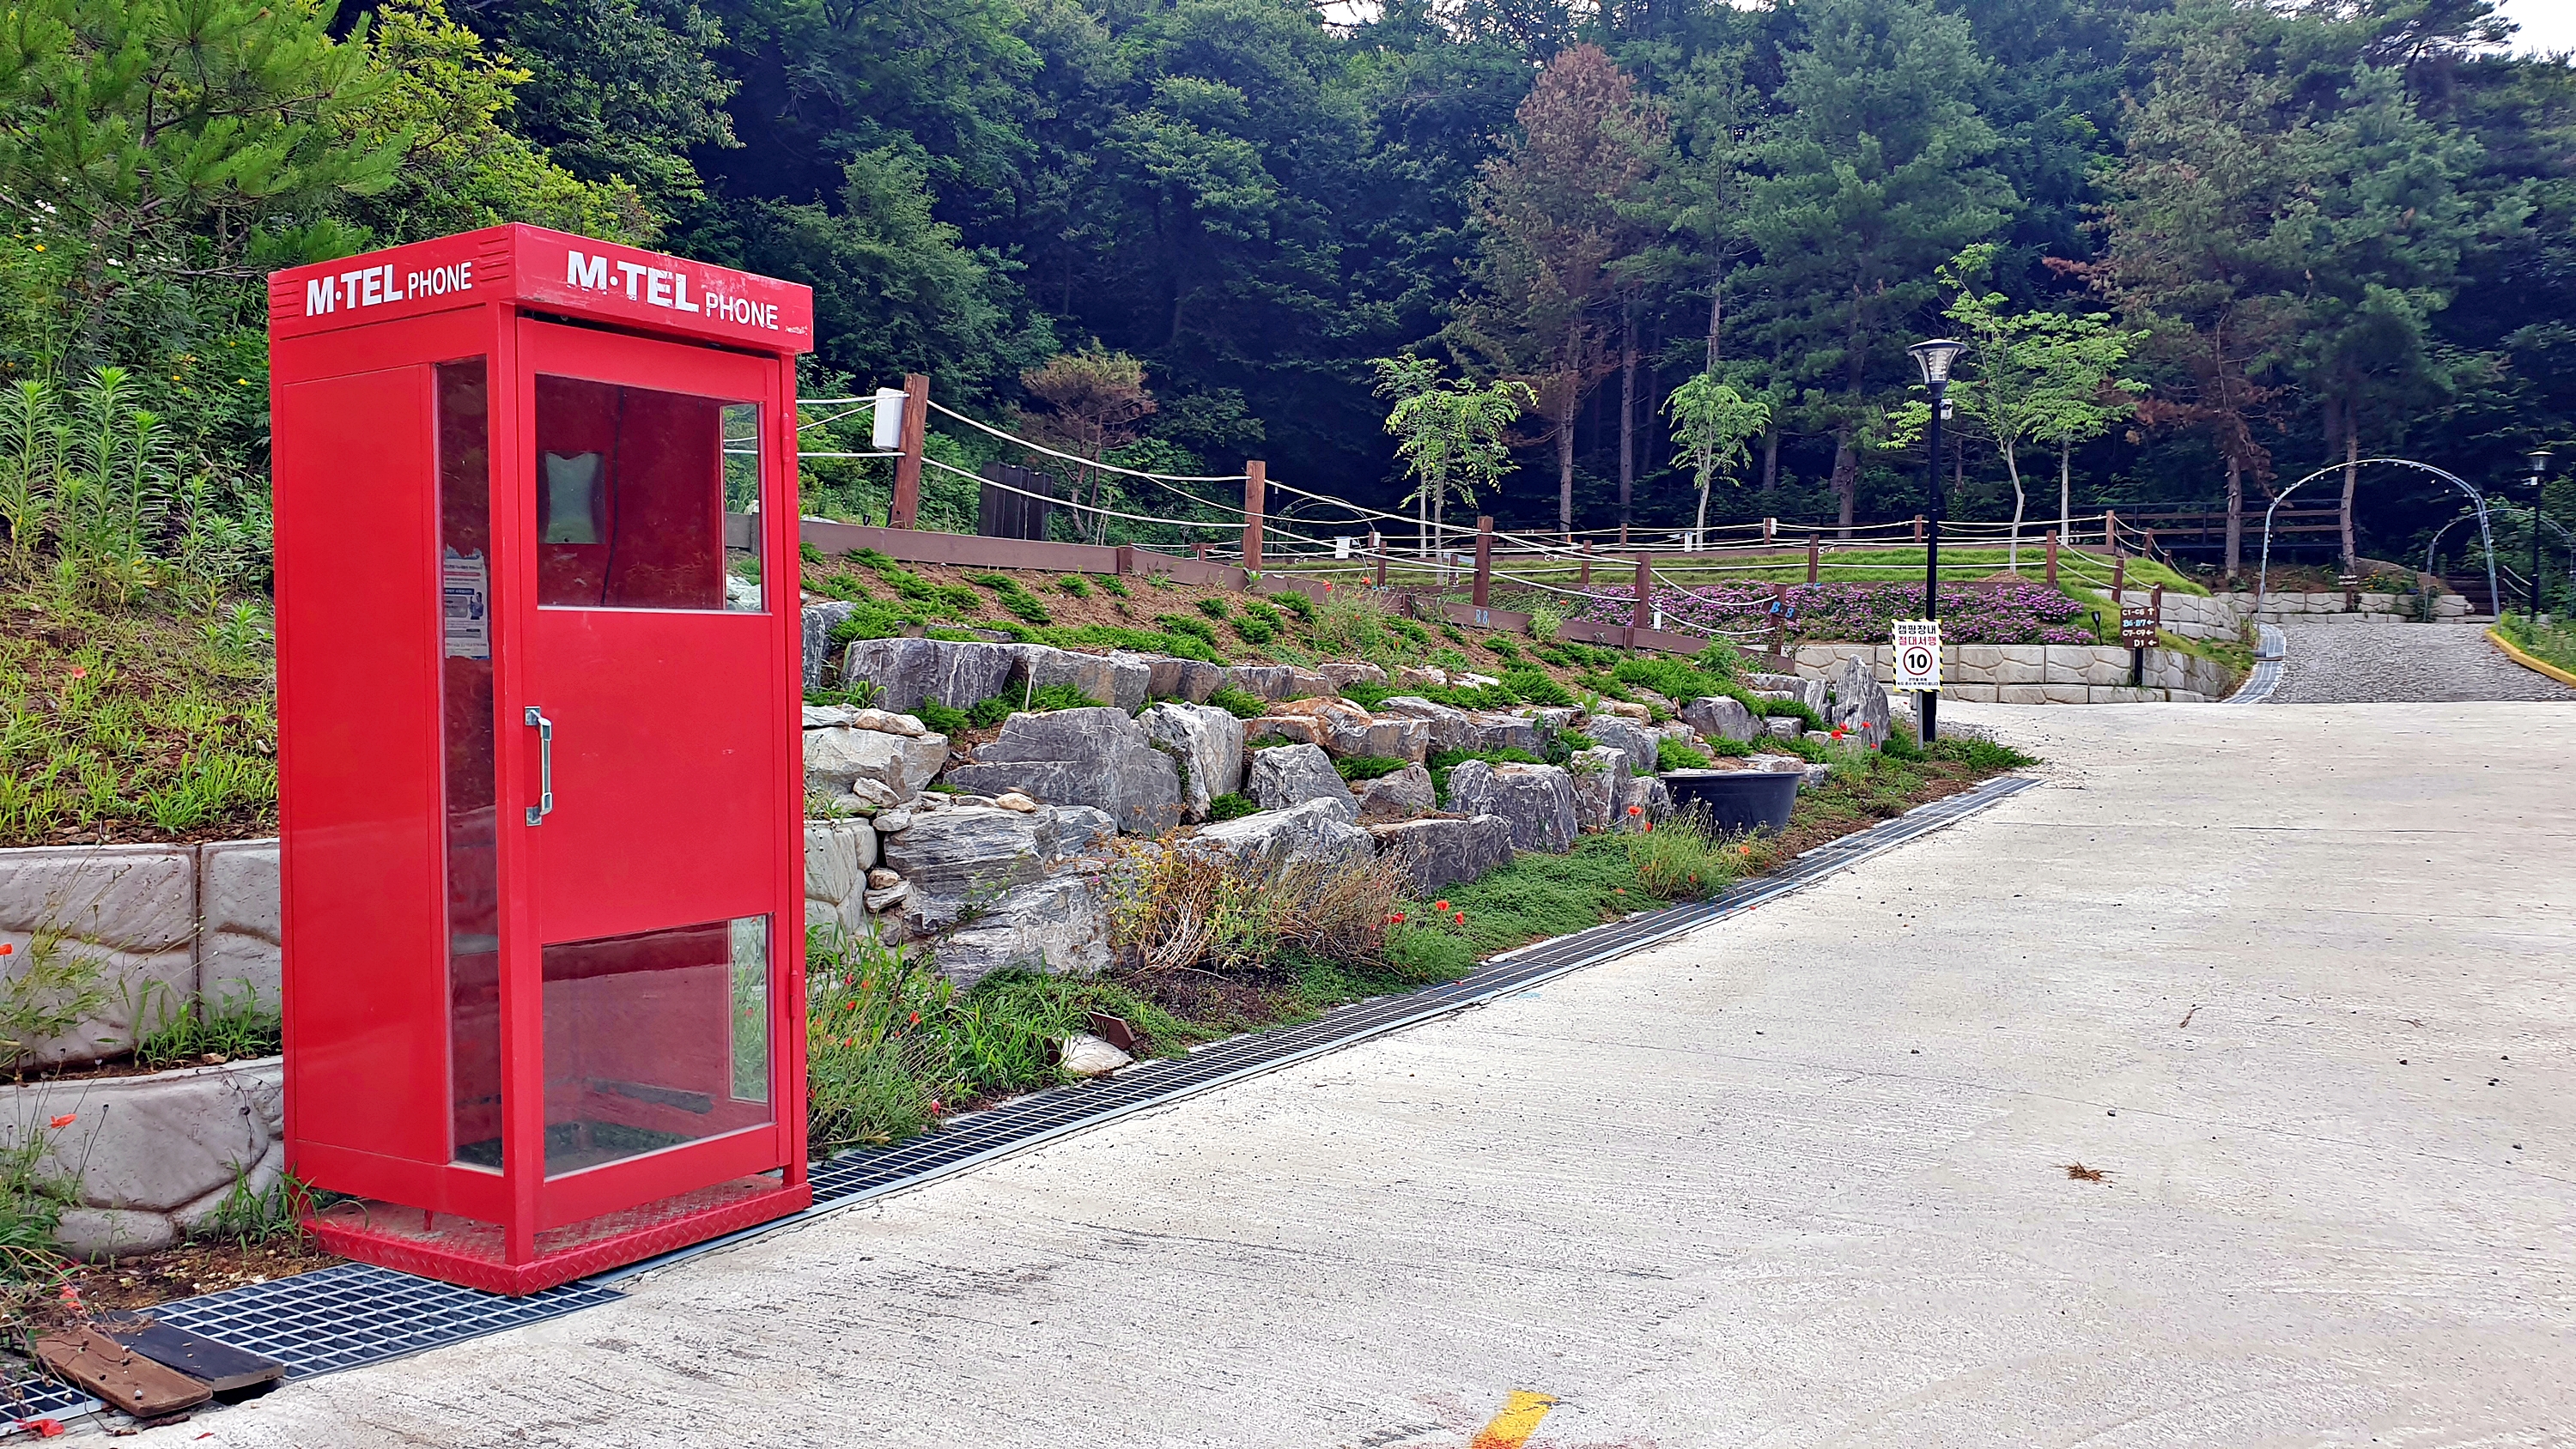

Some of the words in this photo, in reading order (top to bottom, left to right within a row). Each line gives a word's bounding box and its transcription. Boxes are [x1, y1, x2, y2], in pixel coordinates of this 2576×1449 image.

[408, 261, 472, 300] PHONE
[705, 291, 779, 330] PHONE
[1898, 624, 1936, 634] 캠핑장내
[1899, 635, 1936, 646] 절대서행
[1908, 653, 1928, 669] 10
